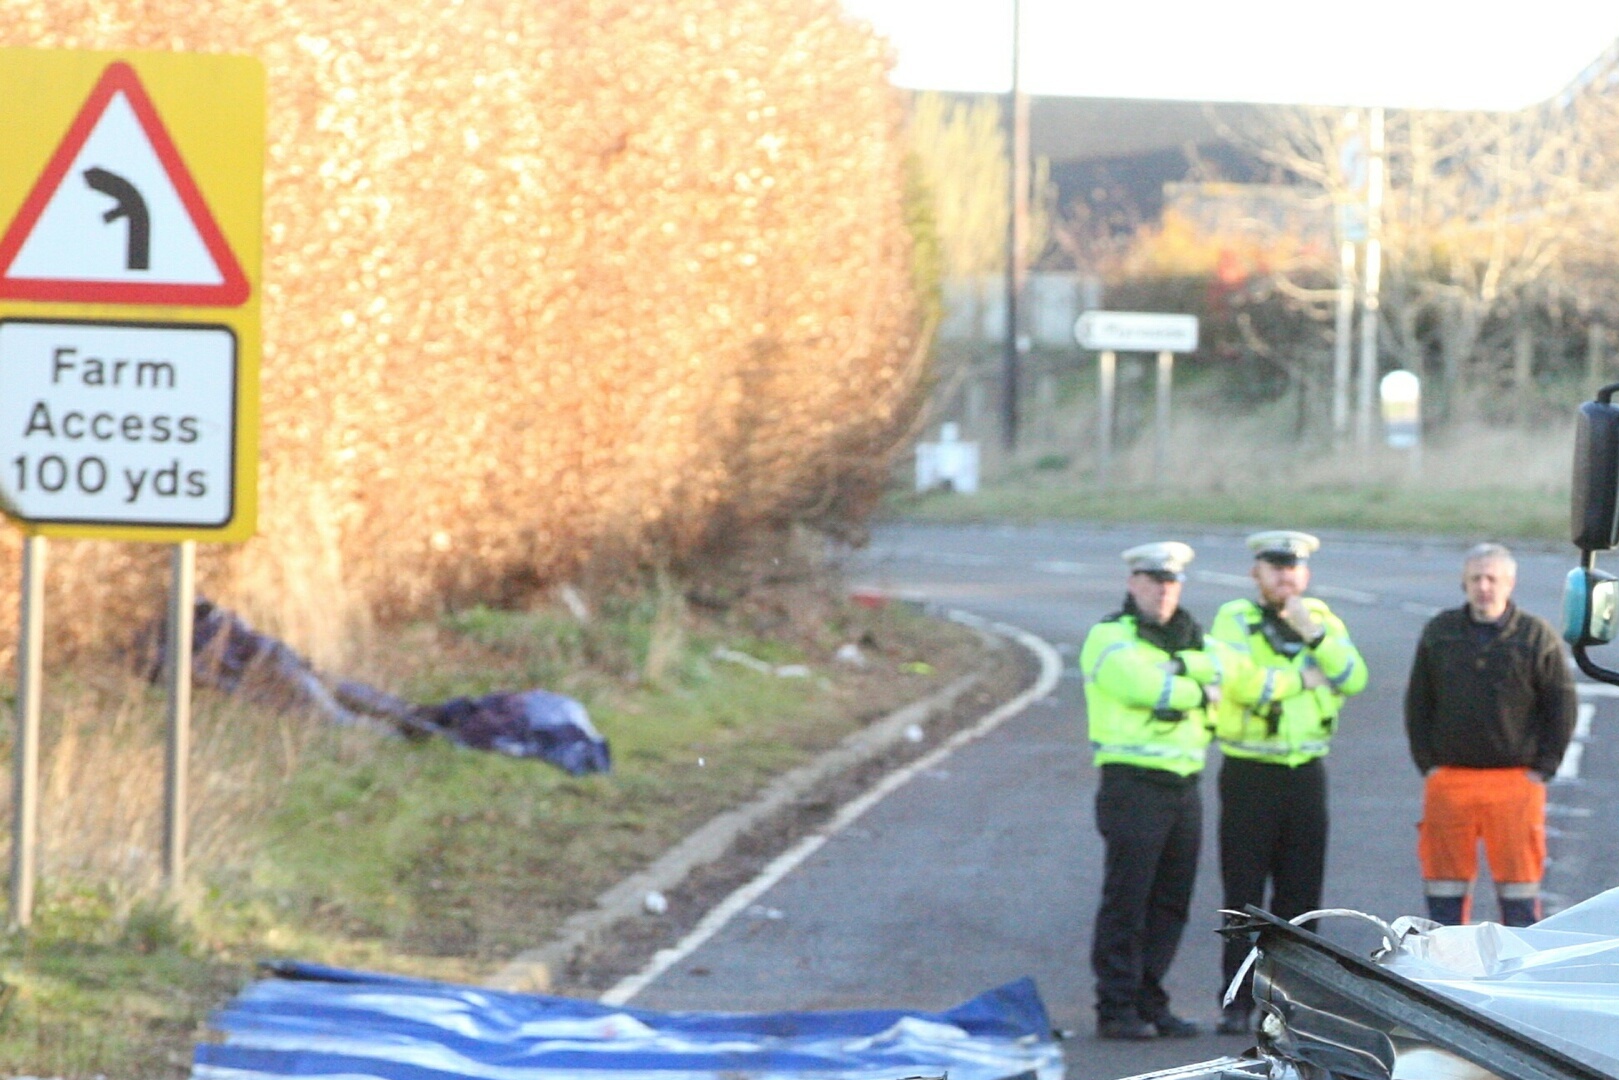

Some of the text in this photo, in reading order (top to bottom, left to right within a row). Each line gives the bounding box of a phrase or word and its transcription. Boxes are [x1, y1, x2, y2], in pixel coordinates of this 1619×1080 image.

[52, 347, 176, 387] Farm
[24, 401, 199, 443] Access
[14, 454, 208, 503] 100 yds
